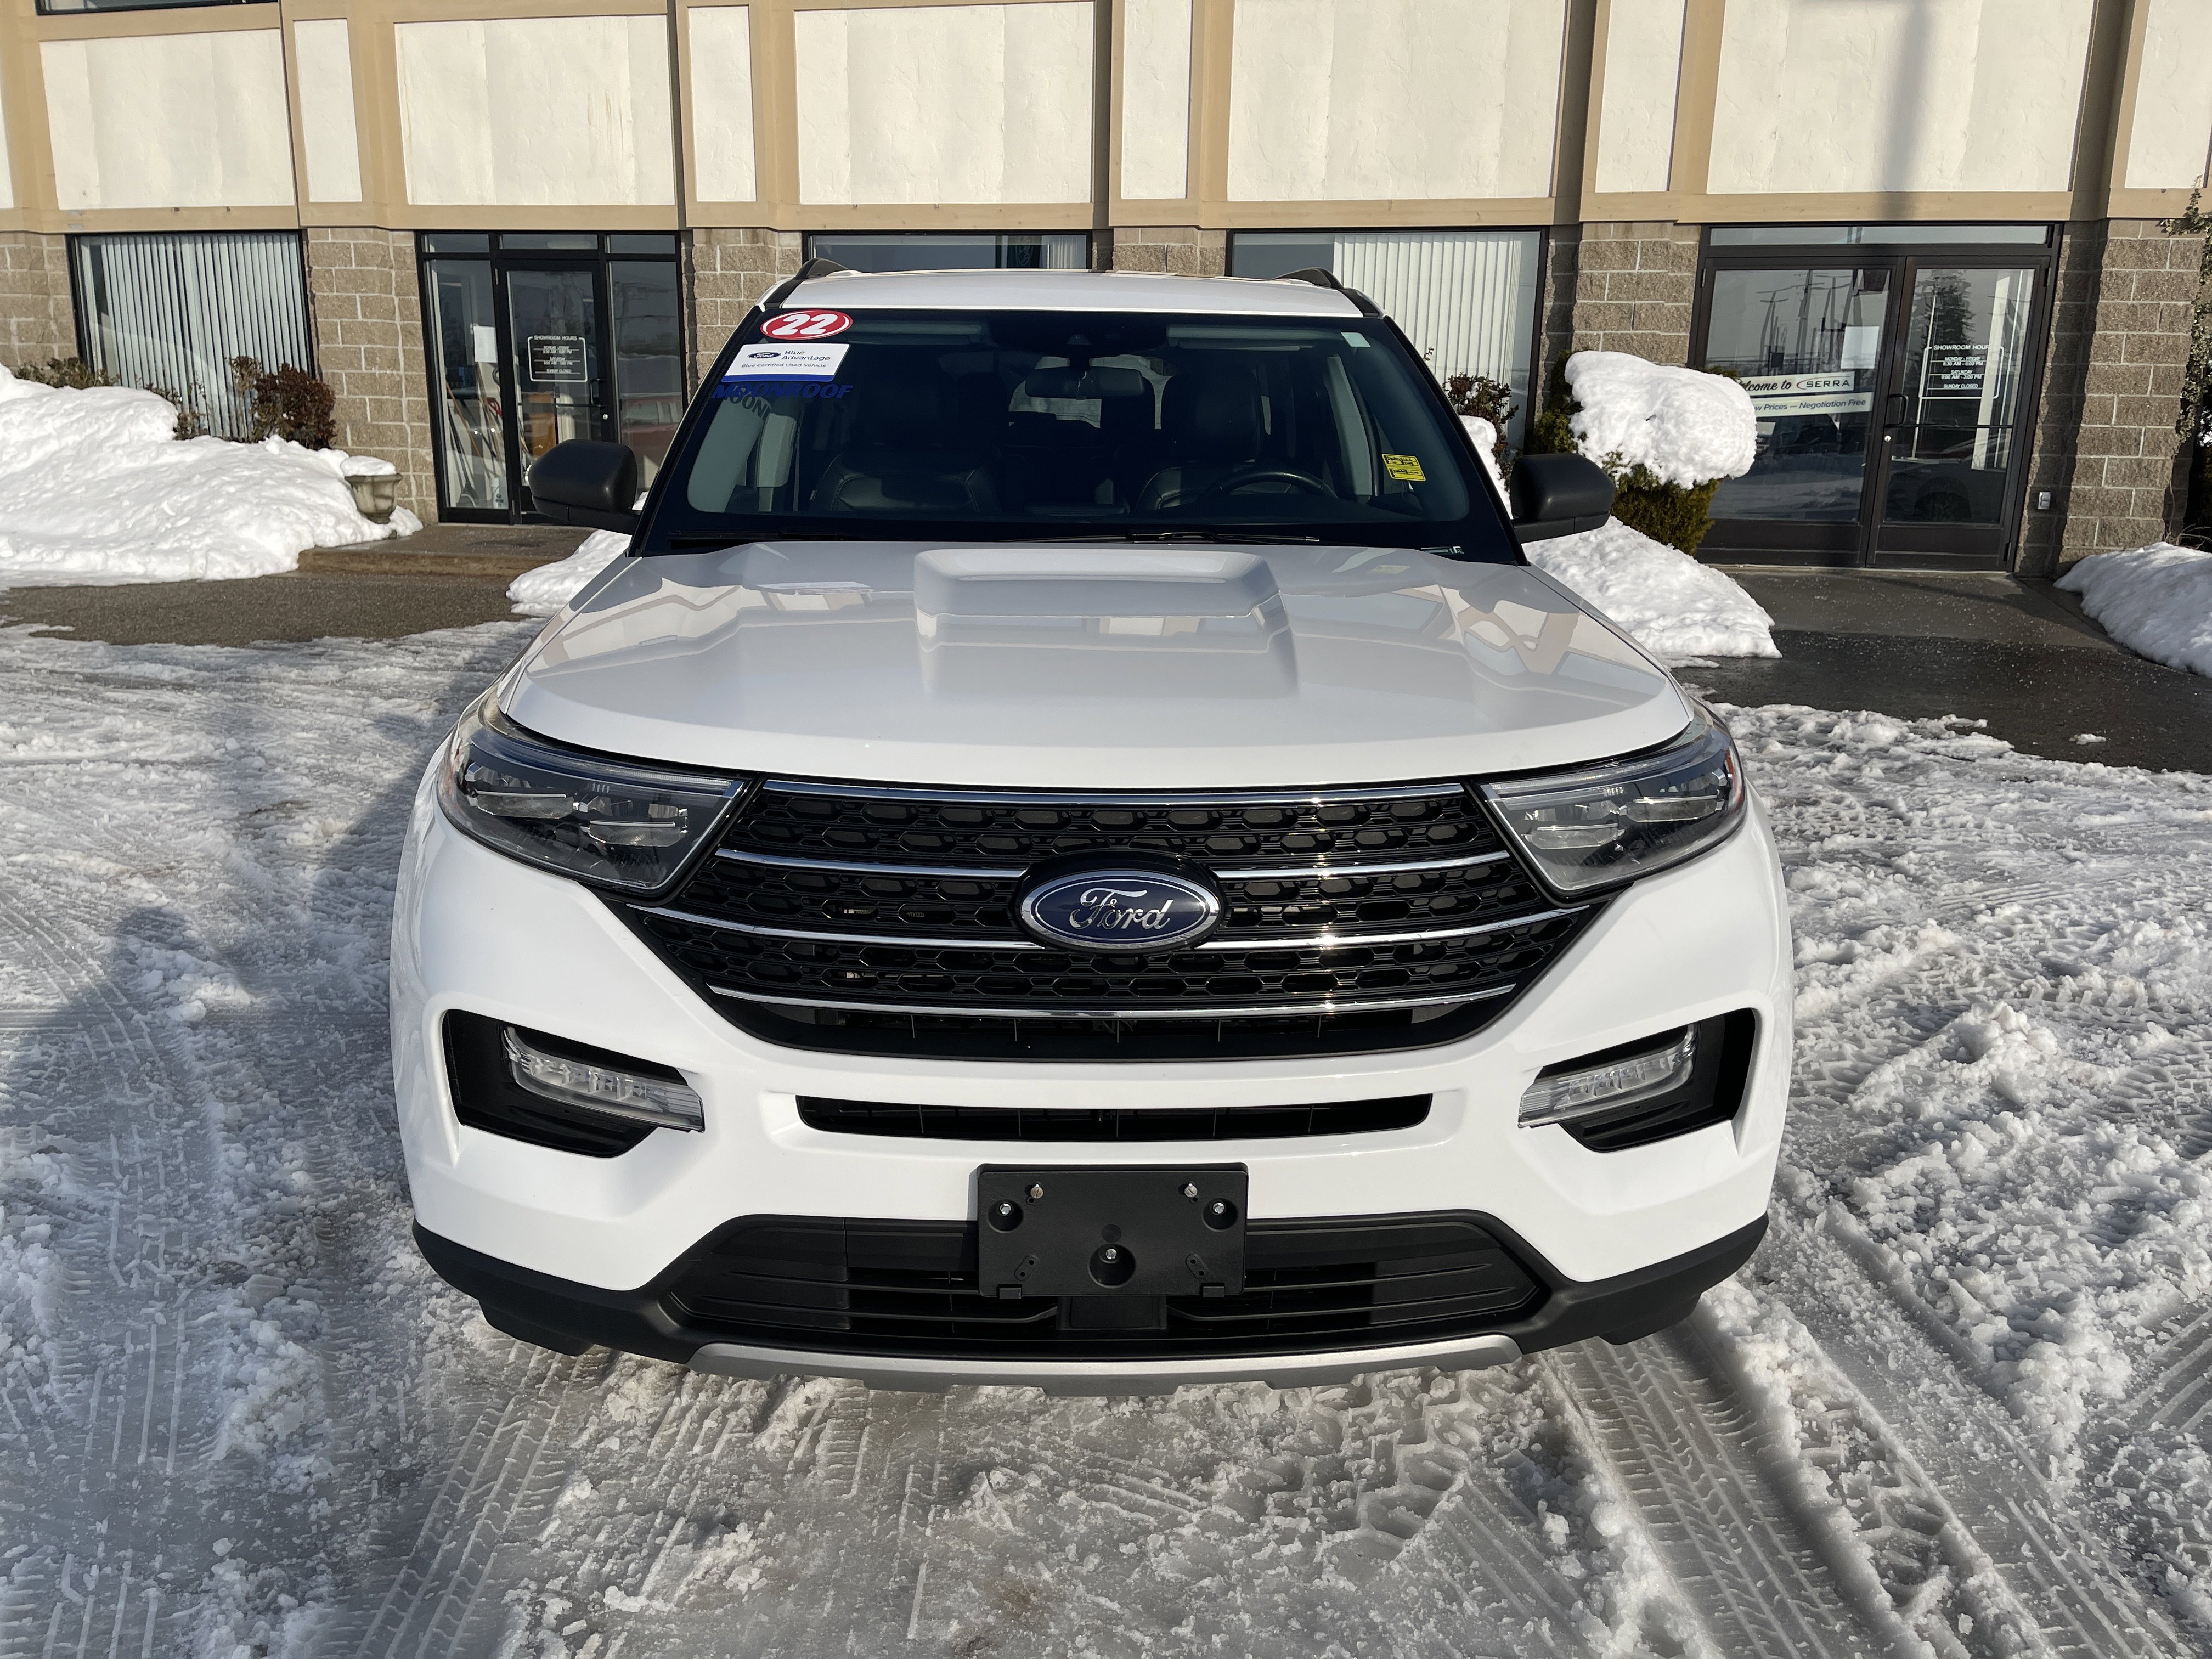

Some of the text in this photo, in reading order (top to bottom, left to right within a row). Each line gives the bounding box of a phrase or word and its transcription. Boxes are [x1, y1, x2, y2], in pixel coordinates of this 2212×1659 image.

[772, 313, 838, 335] 22
[711, 383, 853, 399] MOONROOF
[1745, 379, 1850, 391] lcome to SERRA
[1799, 401, 1846, 410] Negotiation
[1069, 887, 1173, 930] Ford
